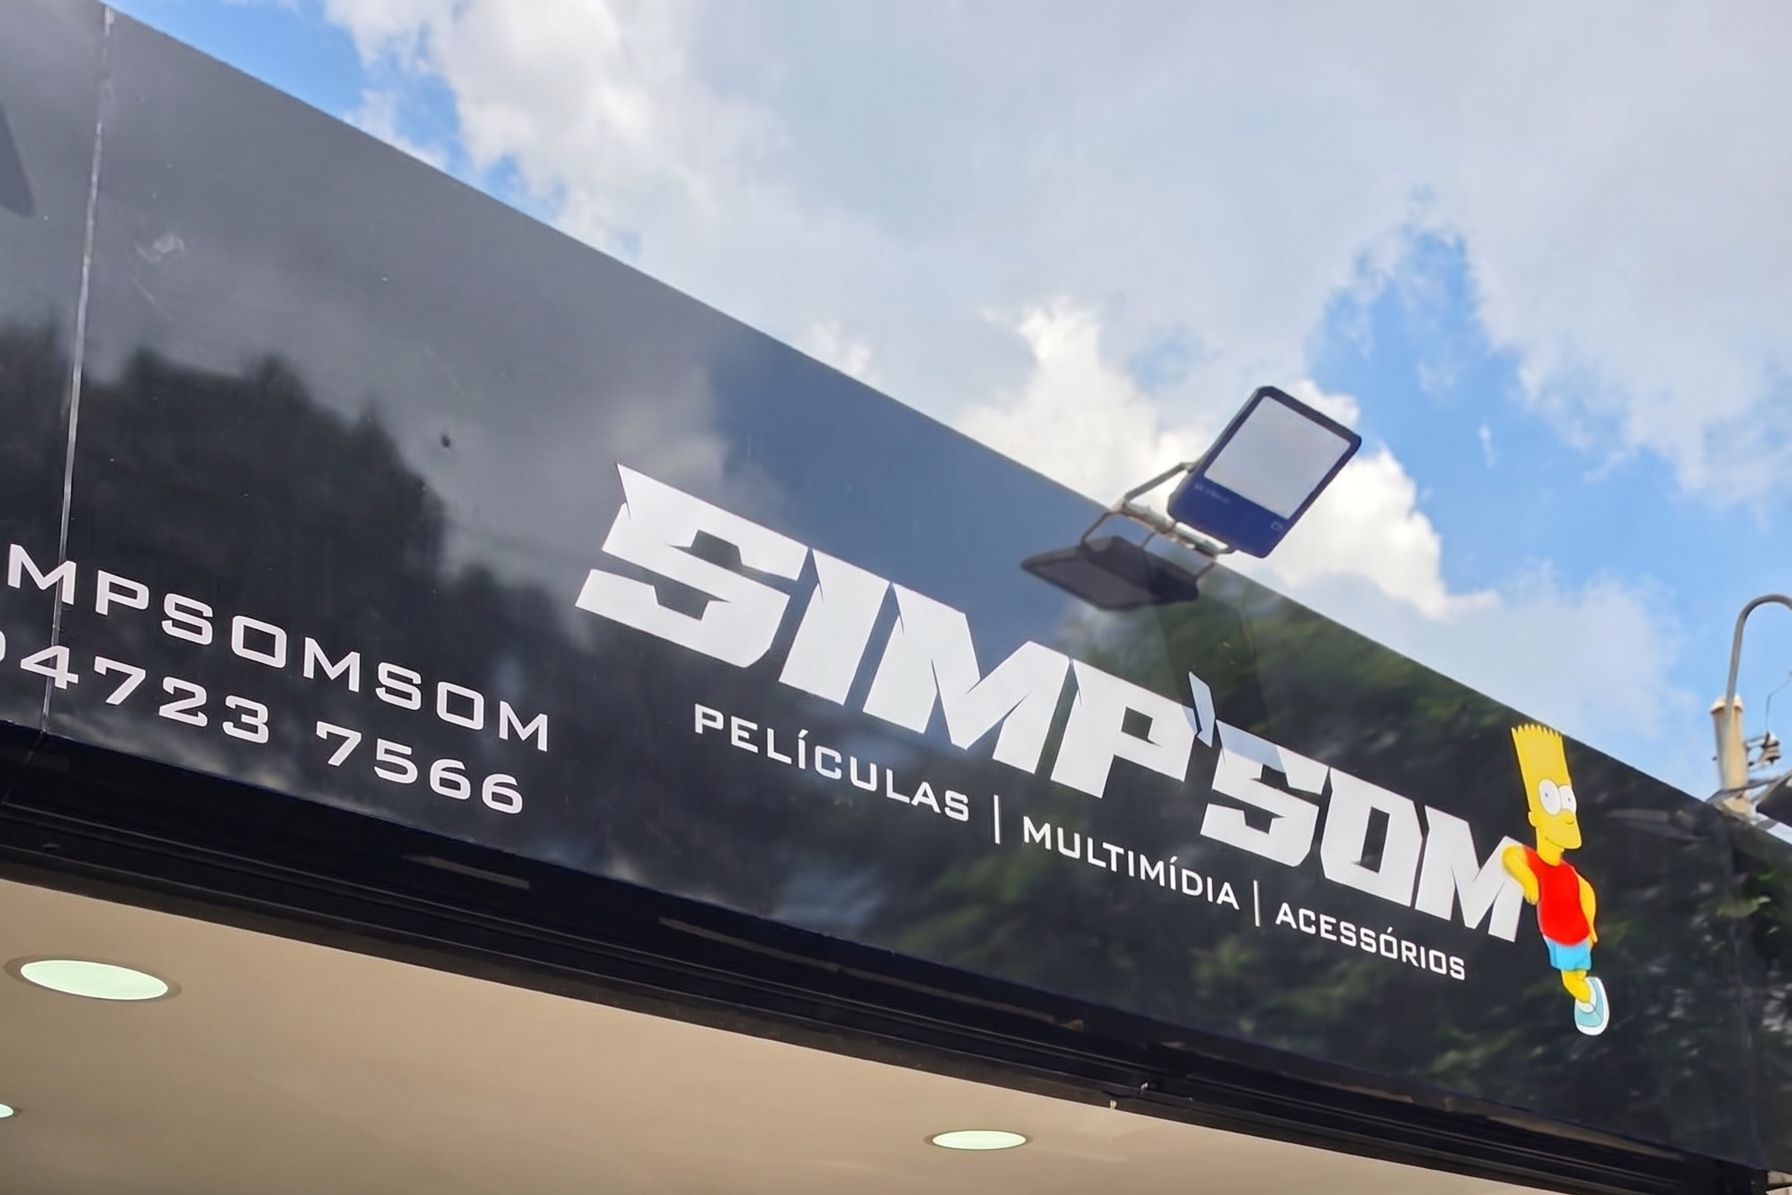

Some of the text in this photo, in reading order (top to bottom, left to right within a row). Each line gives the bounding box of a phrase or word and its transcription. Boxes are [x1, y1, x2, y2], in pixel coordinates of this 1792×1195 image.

[0, 630, 523, 814] 4723 7566
[7, 543, 548, 752] MPSOMSOM
[575, 463, 1525, 943] SIMP'SOM
[694, 703, 970, 822] PELÍCULAS
[1023, 816, 1240, 910] MULTIMÍDIA
[1275, 901, 1466, 981] ACESSÓRIOS
